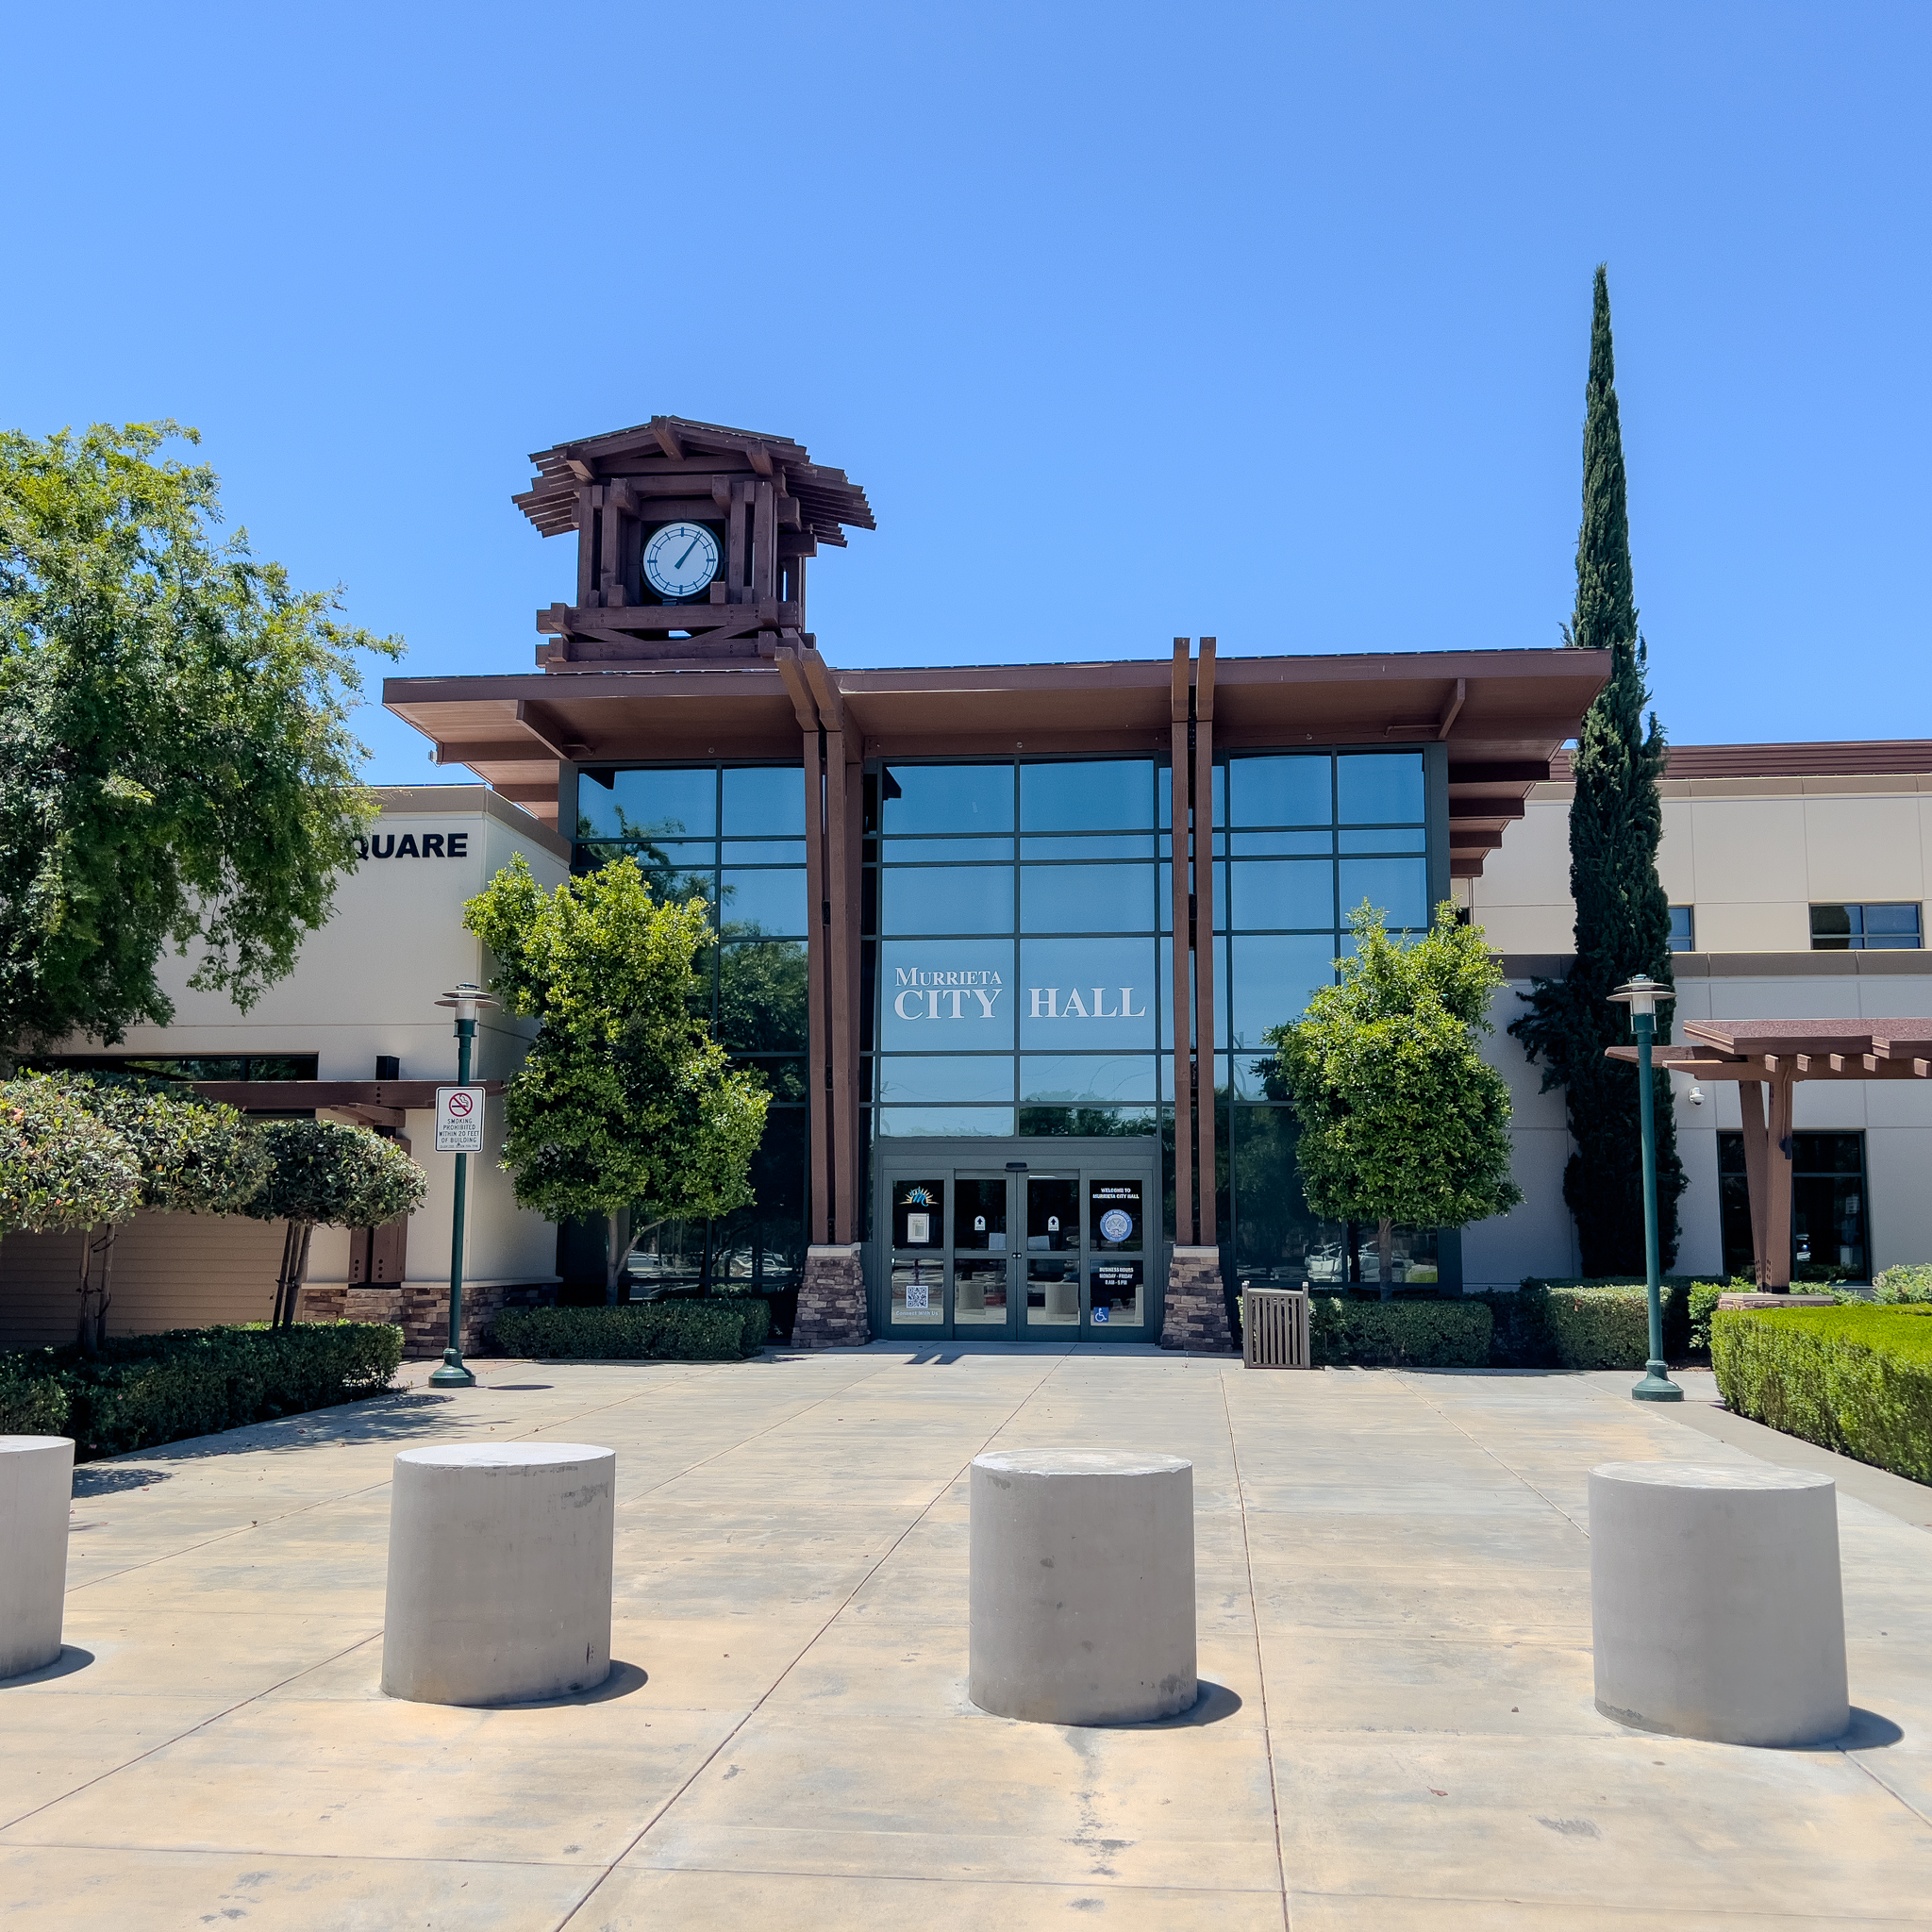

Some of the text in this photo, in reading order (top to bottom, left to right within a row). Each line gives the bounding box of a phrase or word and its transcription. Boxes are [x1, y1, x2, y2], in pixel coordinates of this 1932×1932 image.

[352, 833, 468, 860] QUARE
[894, 987, 1146, 1020] CITY HALL
